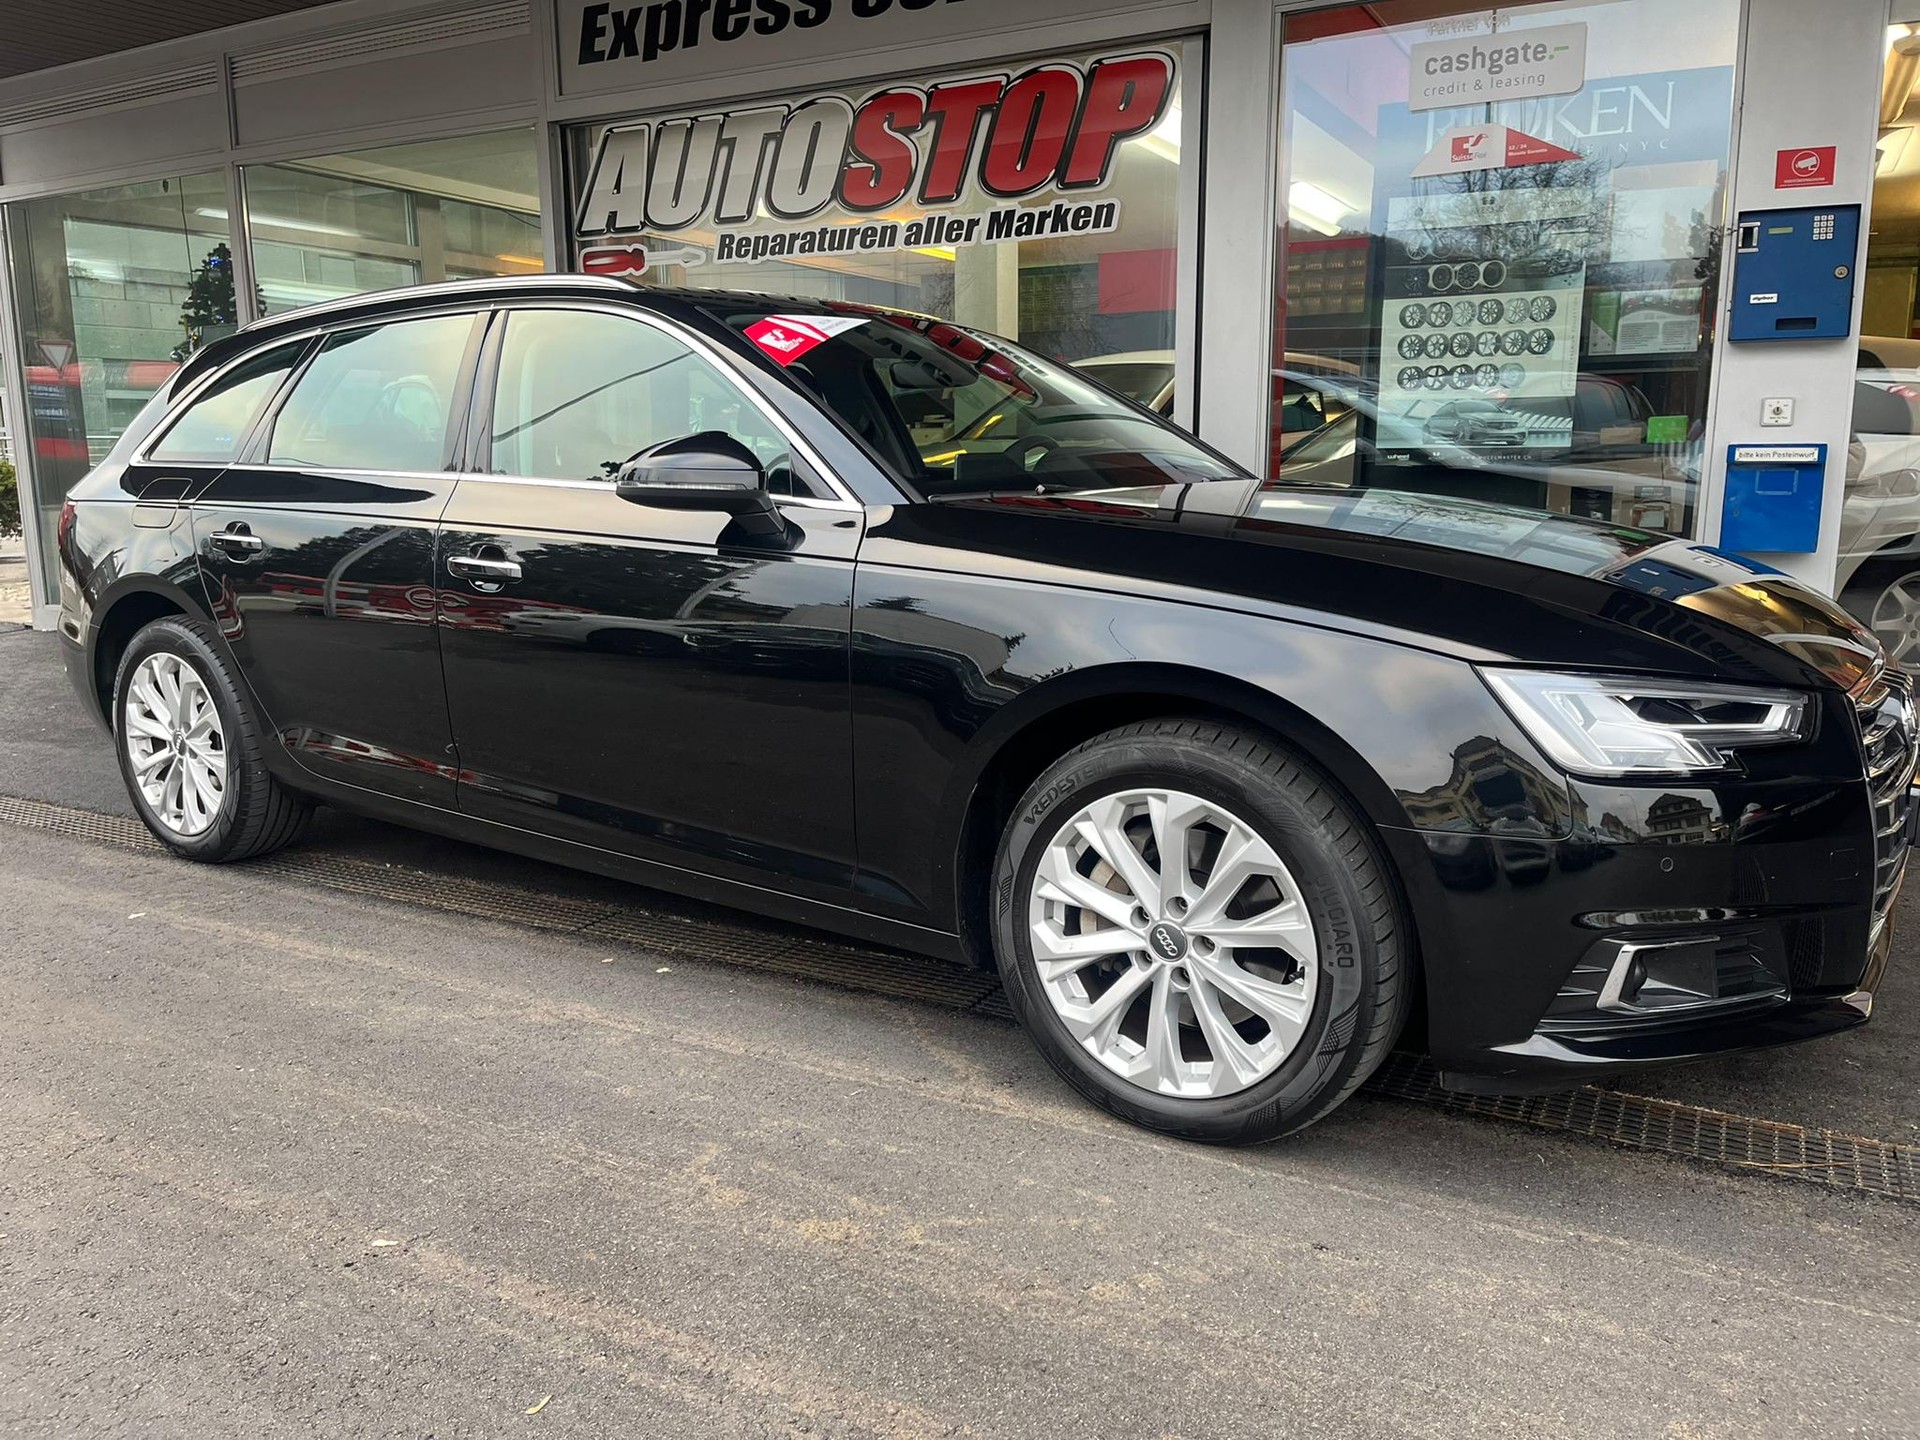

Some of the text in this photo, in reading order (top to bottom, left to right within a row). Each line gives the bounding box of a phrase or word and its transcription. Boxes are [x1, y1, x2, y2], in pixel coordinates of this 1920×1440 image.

[1424, 72, 1546, 97] credit & leasing
[577, 52, 1172, 236] AUTOSTOP
[717, 202, 1116, 261] Reparaturen aller Marken
